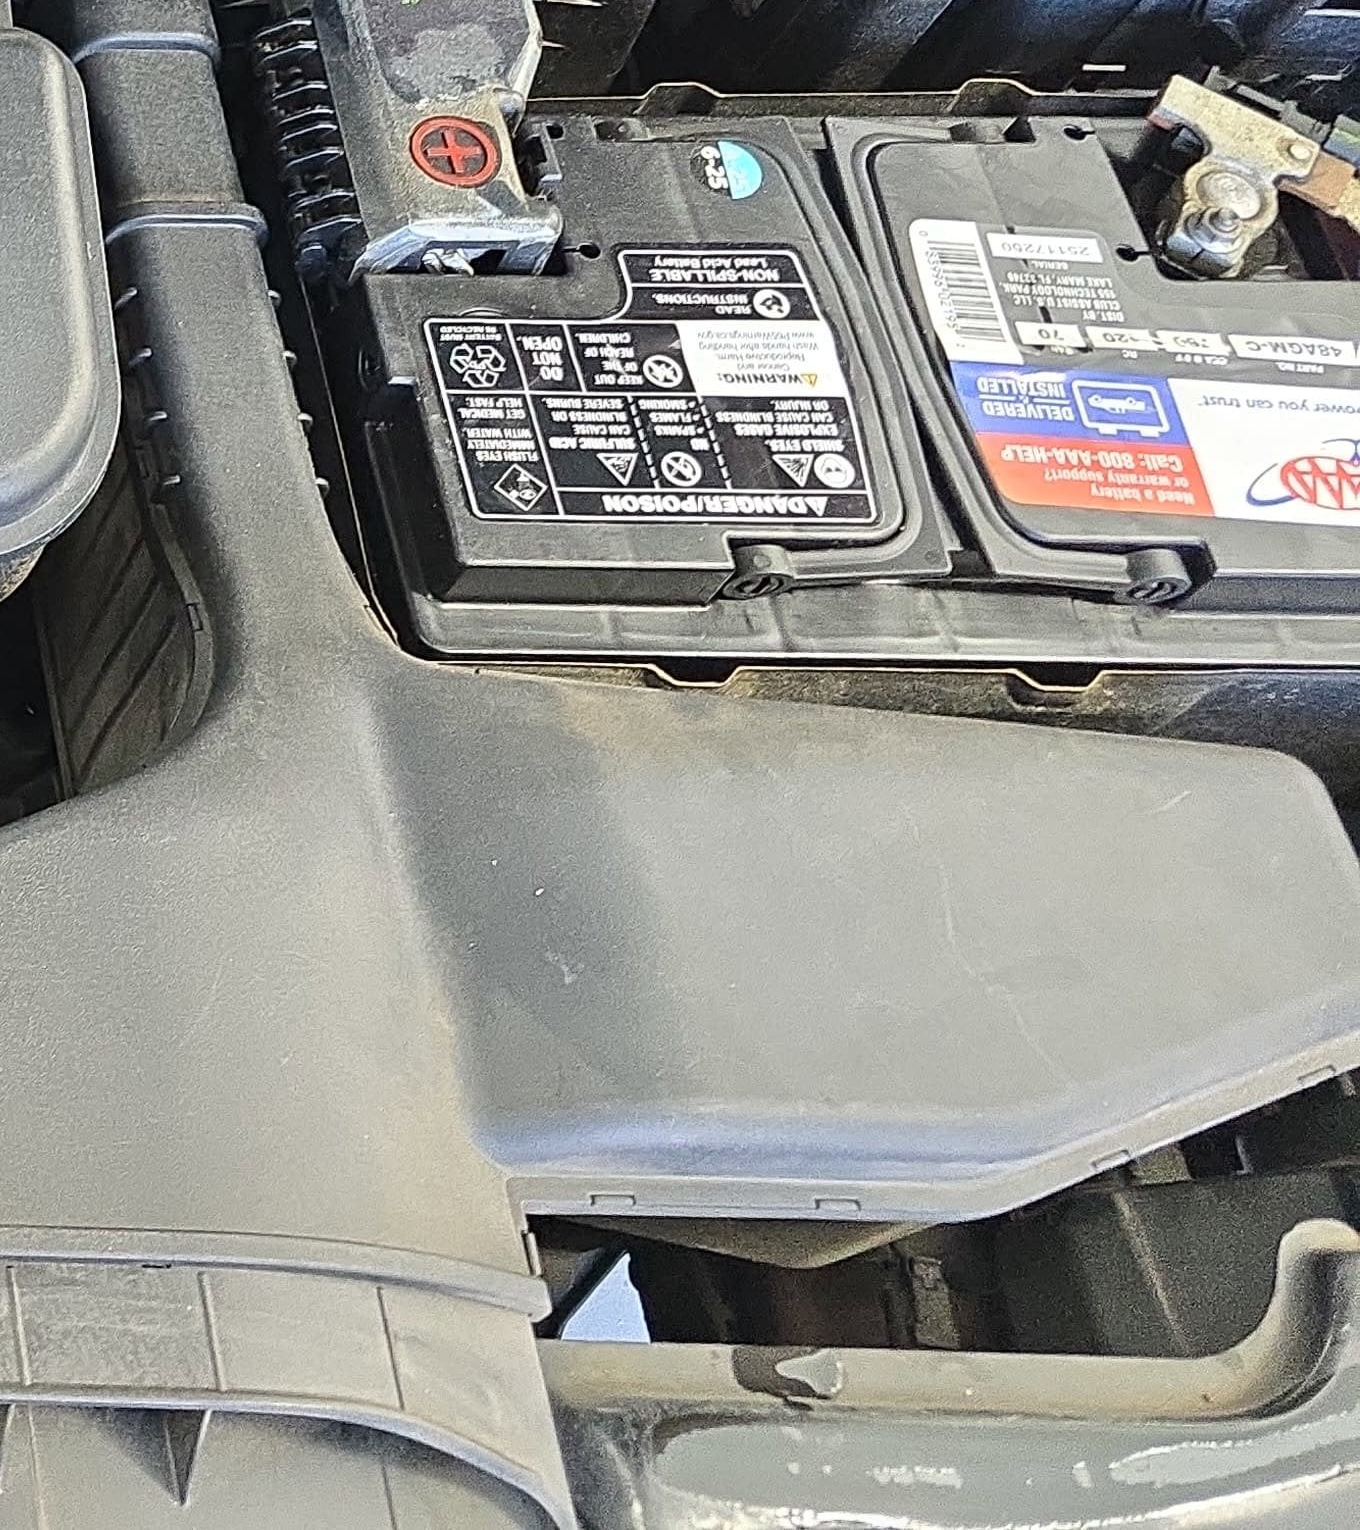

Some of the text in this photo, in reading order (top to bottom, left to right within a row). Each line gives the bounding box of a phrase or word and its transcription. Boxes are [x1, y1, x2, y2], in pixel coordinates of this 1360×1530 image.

[701, 145, 729, 190] 6-25
[654, 256, 767, 268] Lead Acid Battery
[1031, 260, 1069, 270] SERIAL
[649, 268, 779, 281] NON-SPILLABLE
[1038, 275, 1050, 284] FL
[1052, 275, 1085, 286] MARY,
[1086, 277, 1112, 288] LAKE
[1000, 283, 1115, 298] 155 TECHNOLOGY PARK,
[1013, 295, 1120, 310] CLUB ASSIST U.S. LLC
[716, 305, 752, 314] READ
[1083, 310, 1124, 322] DIST. BY
[575, 332, 630, 344] CHILDREN.
[1037, 328, 1065, 341] 70
[517, 336, 562, 350] OPEN.
[698, 342, 738, 351] handling
[763, 343, 790, 351] hands
[584, 347, 634, 358] REACH OF
[1122, 350, 1138, 358] RC
[1245, 340, 1343, 358] 48AGM-C
[532, 352, 562, 365] NOT
[601, 360, 638, 372] OF THE
[1296, 363, 1325, 374] PART
[540, 367, 563, 380] DO
[717, 373, 801, 384] WARNING:
[593, 374, 644, 385] KEEP OUT
[977, 376, 1065, 397] INSTALLED
[496, 398, 522, 408] HELP
[584, 398, 623, 409] SEVERE
[638, 399, 689, 409] SMOKING
[770, 400, 829, 410] OR INJURY.
[1246, 398, 1273, 410] can
[1278, 399, 1309, 412] you
[458, 408, 526, 419] GET MEDICAL
[982, 400, 1075, 420] DELIVERED
[551, 411, 627, 422] BLINDNESS OR
[649, 412, 692, 422] FLAMES
[715, 411, 833, 422] CAN CAUSE BLINDNESS
[462, 427, 532, 438] WITH WATER.
[573, 424, 630, 435] CAN CAUSE
[654, 425, 696, 436] SPARKS
[734, 424, 838, 435] EXPLOSIVE GASES
[467, 439, 535, 449] IMMEDIATELY
[549, 437, 636, 449] SULFURIC ACID
[765, 439, 845, 451] SHIELD EYES.
[476, 451, 538, 461] FLUSH EYES
[1001, 443, 1183, 471] Call: 800-AAA-HELP
[1044, 466, 1189, 487] or warranty support?
[1090, 483, 1194, 504] Need a battery
[601, 494, 806, 516] DANGER/POISON
